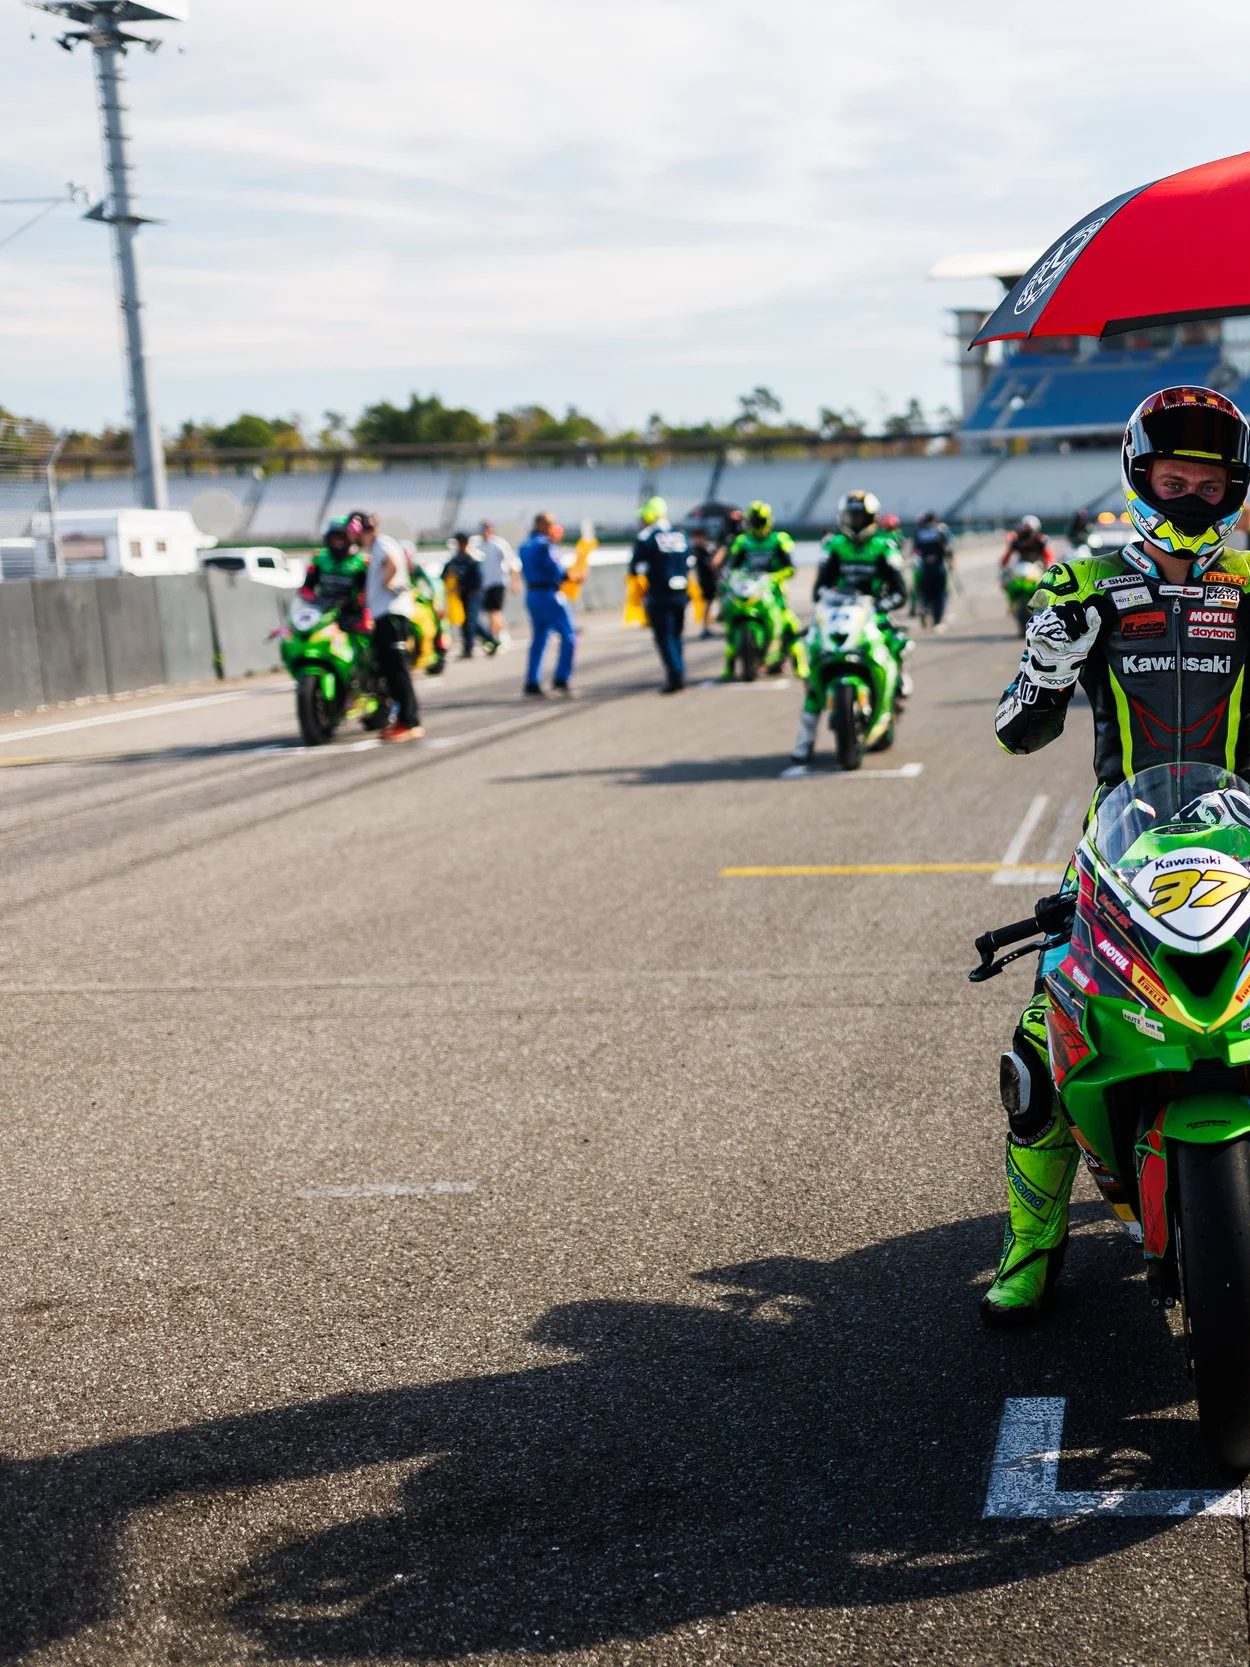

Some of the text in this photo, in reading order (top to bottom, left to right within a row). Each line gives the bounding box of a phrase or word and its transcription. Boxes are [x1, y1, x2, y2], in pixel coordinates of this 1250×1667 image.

[1108, 576, 1142, 584] SHARK
[1206, 593, 1238, 601] MOTO
[1189, 611, 1234, 624] MOTUL
[1189, 627, 1236, 639] daytona
[1122, 655, 1232, 674] Kawasaki
[1154, 855, 1221, 871] Kawasaki
[1148, 868, 1250, 919] 37
[1098, 939, 1130, 972] MOTUL
[1137, 975, 1169, 1007] PIRELLI
[1123, 1013, 1141, 1025] NUTZ
